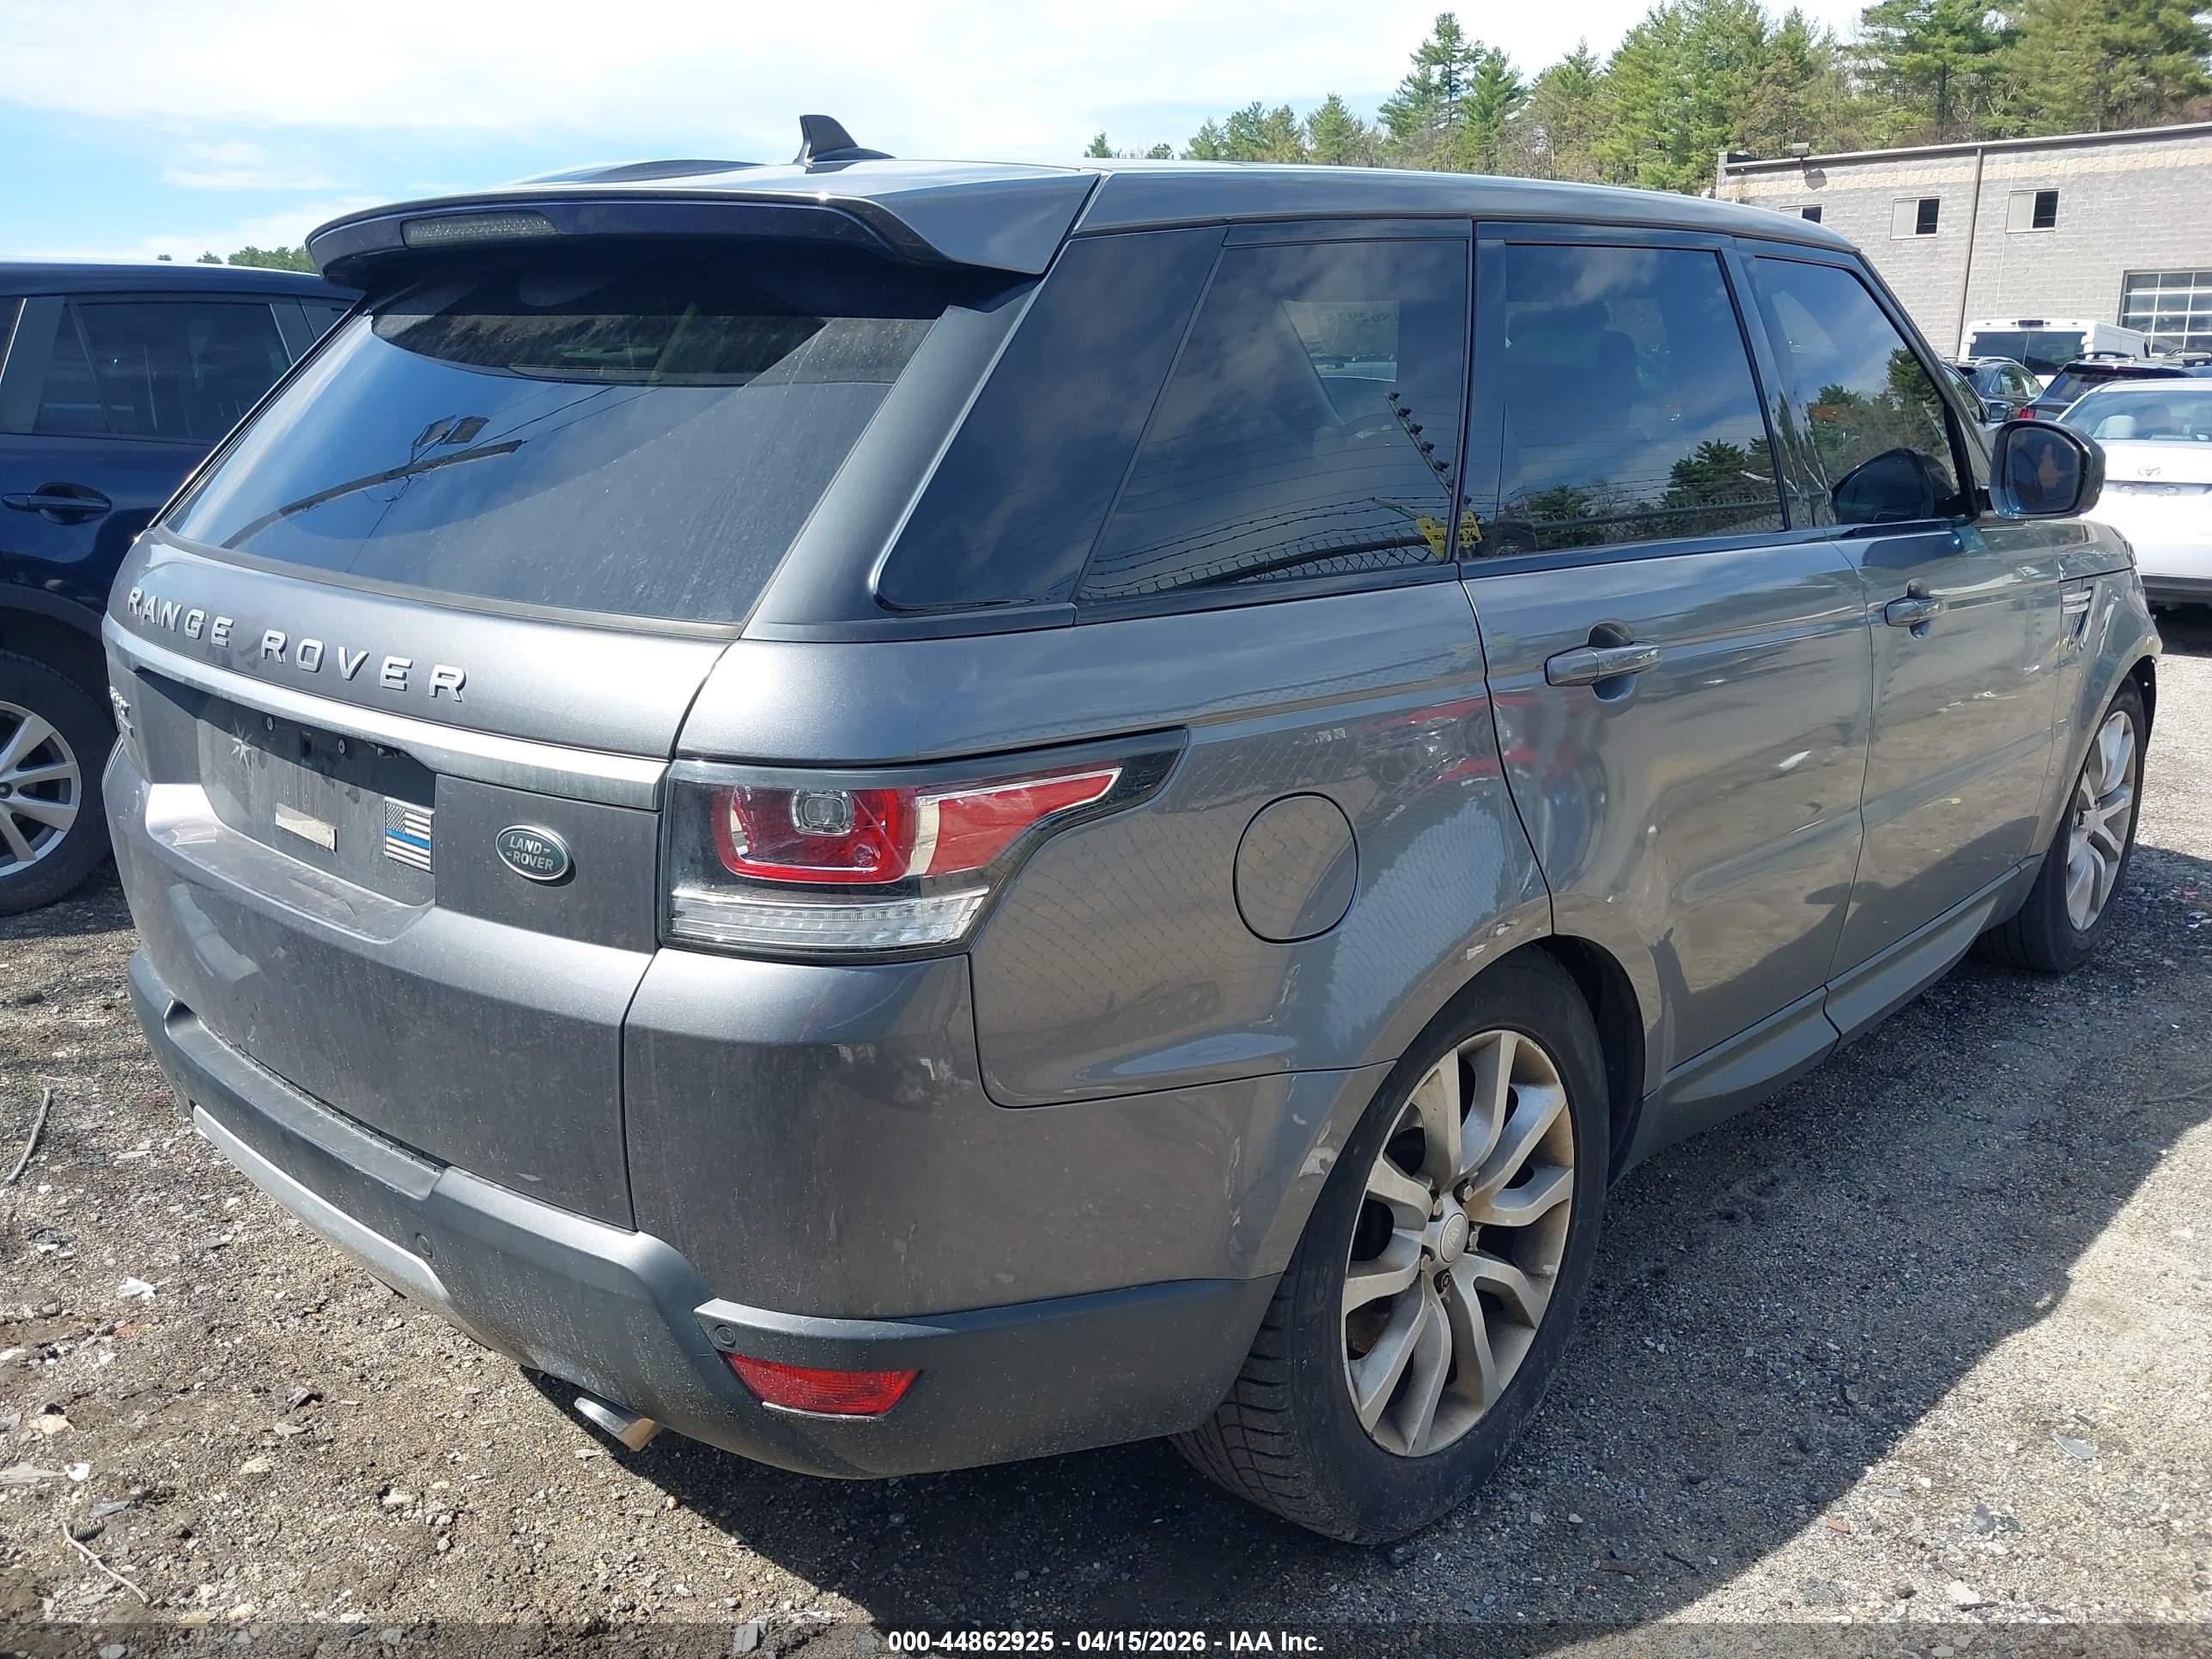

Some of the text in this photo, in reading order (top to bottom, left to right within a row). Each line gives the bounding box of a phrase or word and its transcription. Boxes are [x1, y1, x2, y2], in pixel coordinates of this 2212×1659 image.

[127, 586, 468, 703] RANGE ROVER
[509, 836, 543, 854] LAND
[513, 850, 554, 871] ROVER
